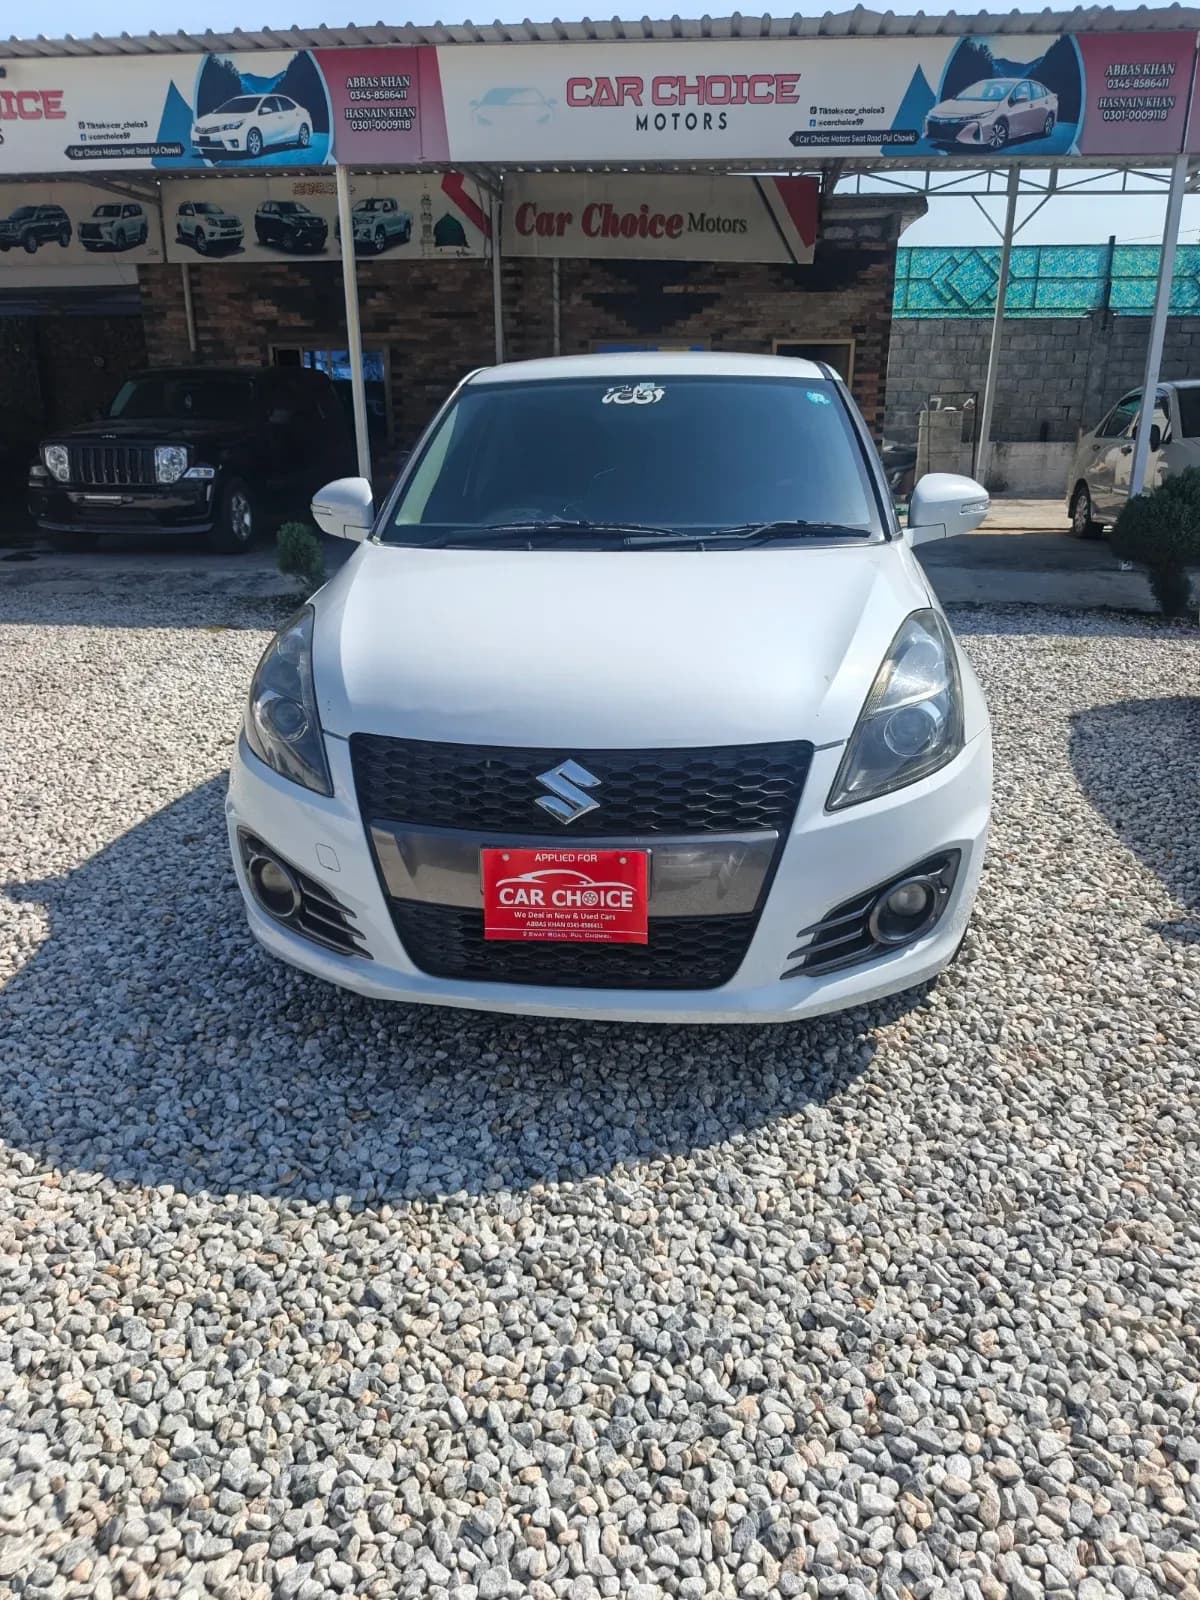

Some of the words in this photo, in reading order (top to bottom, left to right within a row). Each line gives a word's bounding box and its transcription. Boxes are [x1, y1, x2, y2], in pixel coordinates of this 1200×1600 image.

[1105, 64, 1141, 76] ABBAS
[1143, 63, 1176, 75] KHAN
[346, 77, 379, 88] ABBAS
[380, 76, 410, 87] KHAN
[1107, 78, 1169, 89] 0345-8586411
[350, 90, 407, 100] 0345-8586411
[566, 76, 644, 107] CAR
[651, 74, 801, 106] CHOICE
[0, 90, 66, 120] ICE
[1099, 97, 1144, 108] HASNAIN
[1145, 96, 1175, 108] KHAN
[345, 107, 388, 118] HASNAIN
[388, 107, 416, 118] KHAN
[1103, 110, 1168, 120] 0301-0009118
[351, 120, 411, 131] 0301-0009118
[636, 112, 728, 131] MOTORS
[515, 202, 573, 237] Car
[581, 203, 684, 239] Choice
[687, 212, 748, 234] Motors
[535, 853, 576, 863] APPLIED
[577, 854, 598, 863] FOR
[499, 888, 546, 906] CAR
[551, 890, 633, 908] CHOICE
[514, 911, 527, 919] We
[528, 911, 544, 919] Deal
[545, 911, 553, 919] in
[554, 912, 572, 920] New
[572, 912, 579, 920] &
[580, 912, 599, 920] Used
[600, 913, 616, 921] Cars
